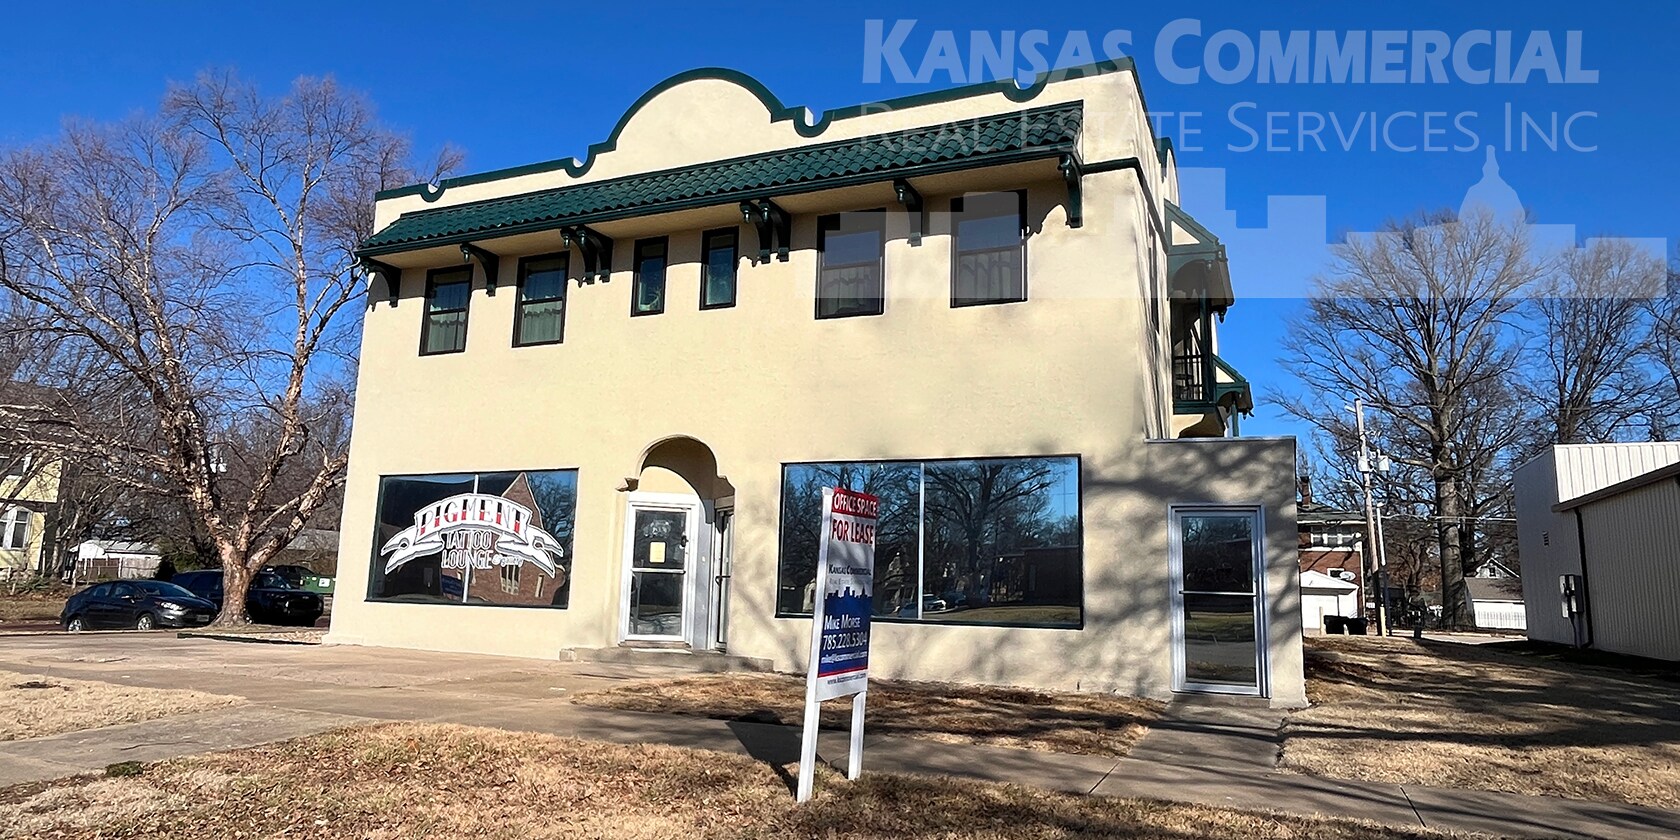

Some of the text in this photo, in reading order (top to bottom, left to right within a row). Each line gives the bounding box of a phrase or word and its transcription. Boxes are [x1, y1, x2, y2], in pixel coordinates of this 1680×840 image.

[420, 498, 526, 536] PIGMENT
[833, 494, 877, 517] OFFICE SPACE
[445, 530, 492, 549] TATTOO
[831, 519, 874, 545] FOR LEASE
[441, 549, 494, 570] LOUNGE
